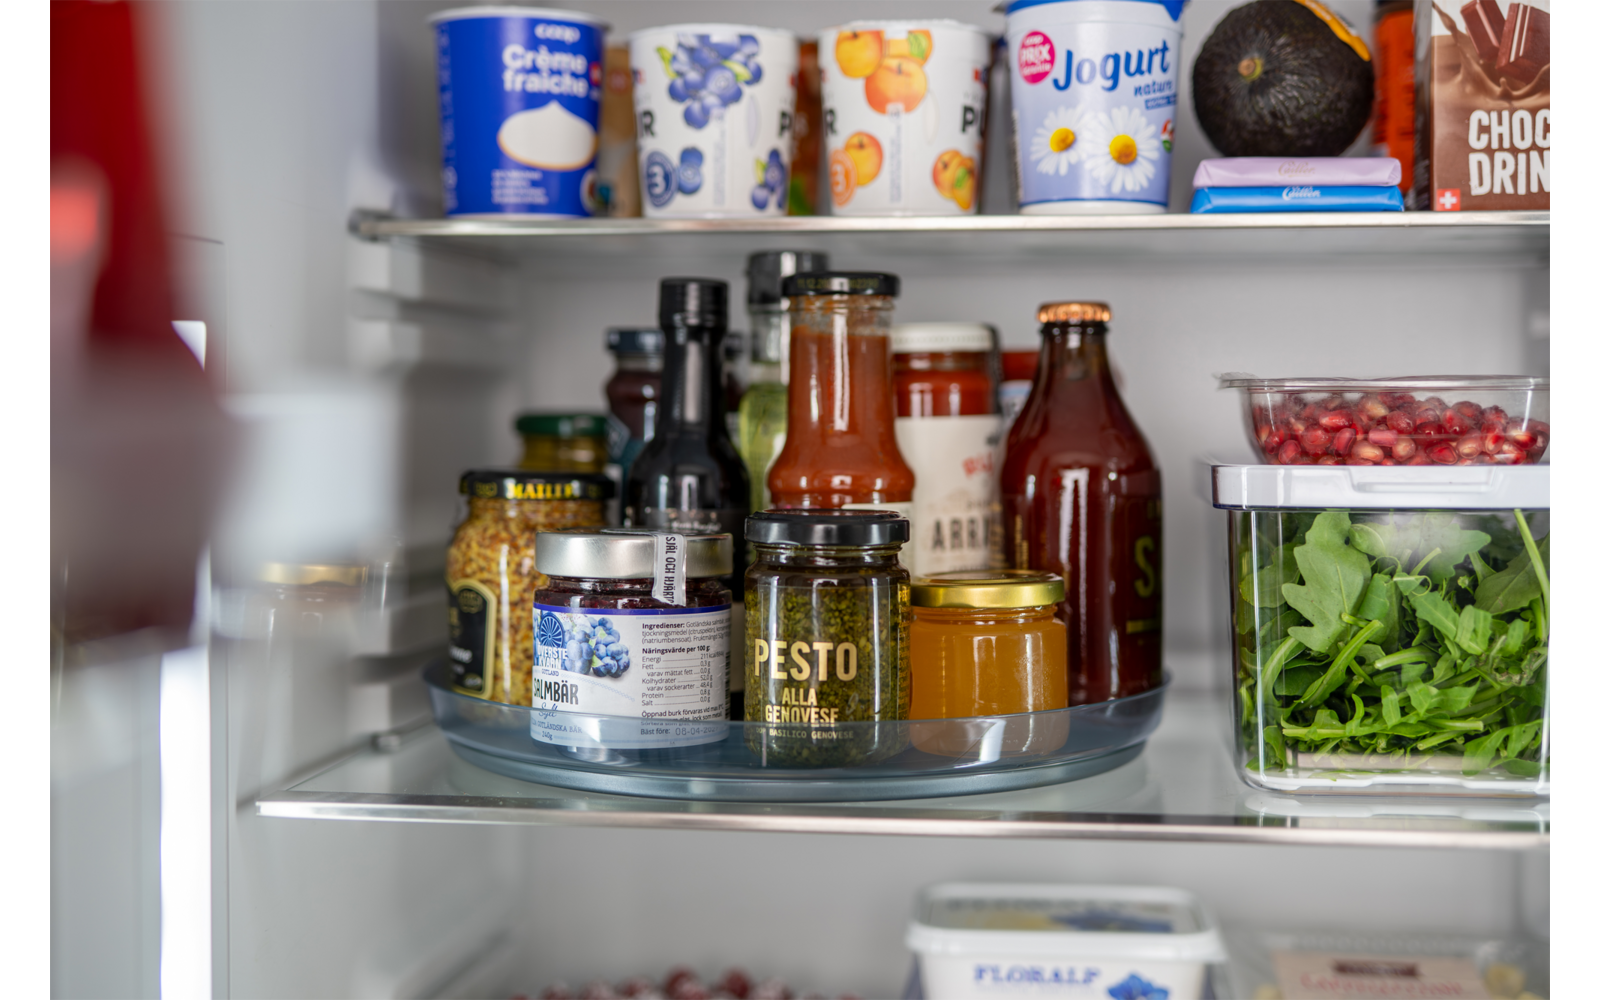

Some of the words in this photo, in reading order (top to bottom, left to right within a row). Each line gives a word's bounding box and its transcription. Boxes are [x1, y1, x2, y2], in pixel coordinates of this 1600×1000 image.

[533, 23, 580, 44] coop
[502, 45, 587, 74] Crème
[1020, 43, 1051, 64] PRIX
[1052, 39, 1170, 92] Jogurt
[665, 536, 678, 555] SJÄL
[664, 557, 676, 574] OCH
[642, 622, 685, 631] Ingredienser:
[642, 629, 687, 638] tjockningsmedel
[642, 646, 685, 655] Näringsvärde
[642, 656, 661, 664] Energi
[754, 638, 858, 682] PESTO
[642, 677, 676, 685] Kolhydrater
[664, 683, 695, 691] sockerarter
[533, 678, 579, 705] SALMBÄR
[781, 687, 818, 706] ALLA
[641, 710, 667, 718] Öppnad
[668, 709, 682, 717] burk
[682, 708, 703, 716] förvaras
[765, 704, 839, 728] GENOVESE
[656, 727, 671, 735] före:
[769, 728, 807, 738] BASILICO
[811, 730, 854, 739] GENOVESE
